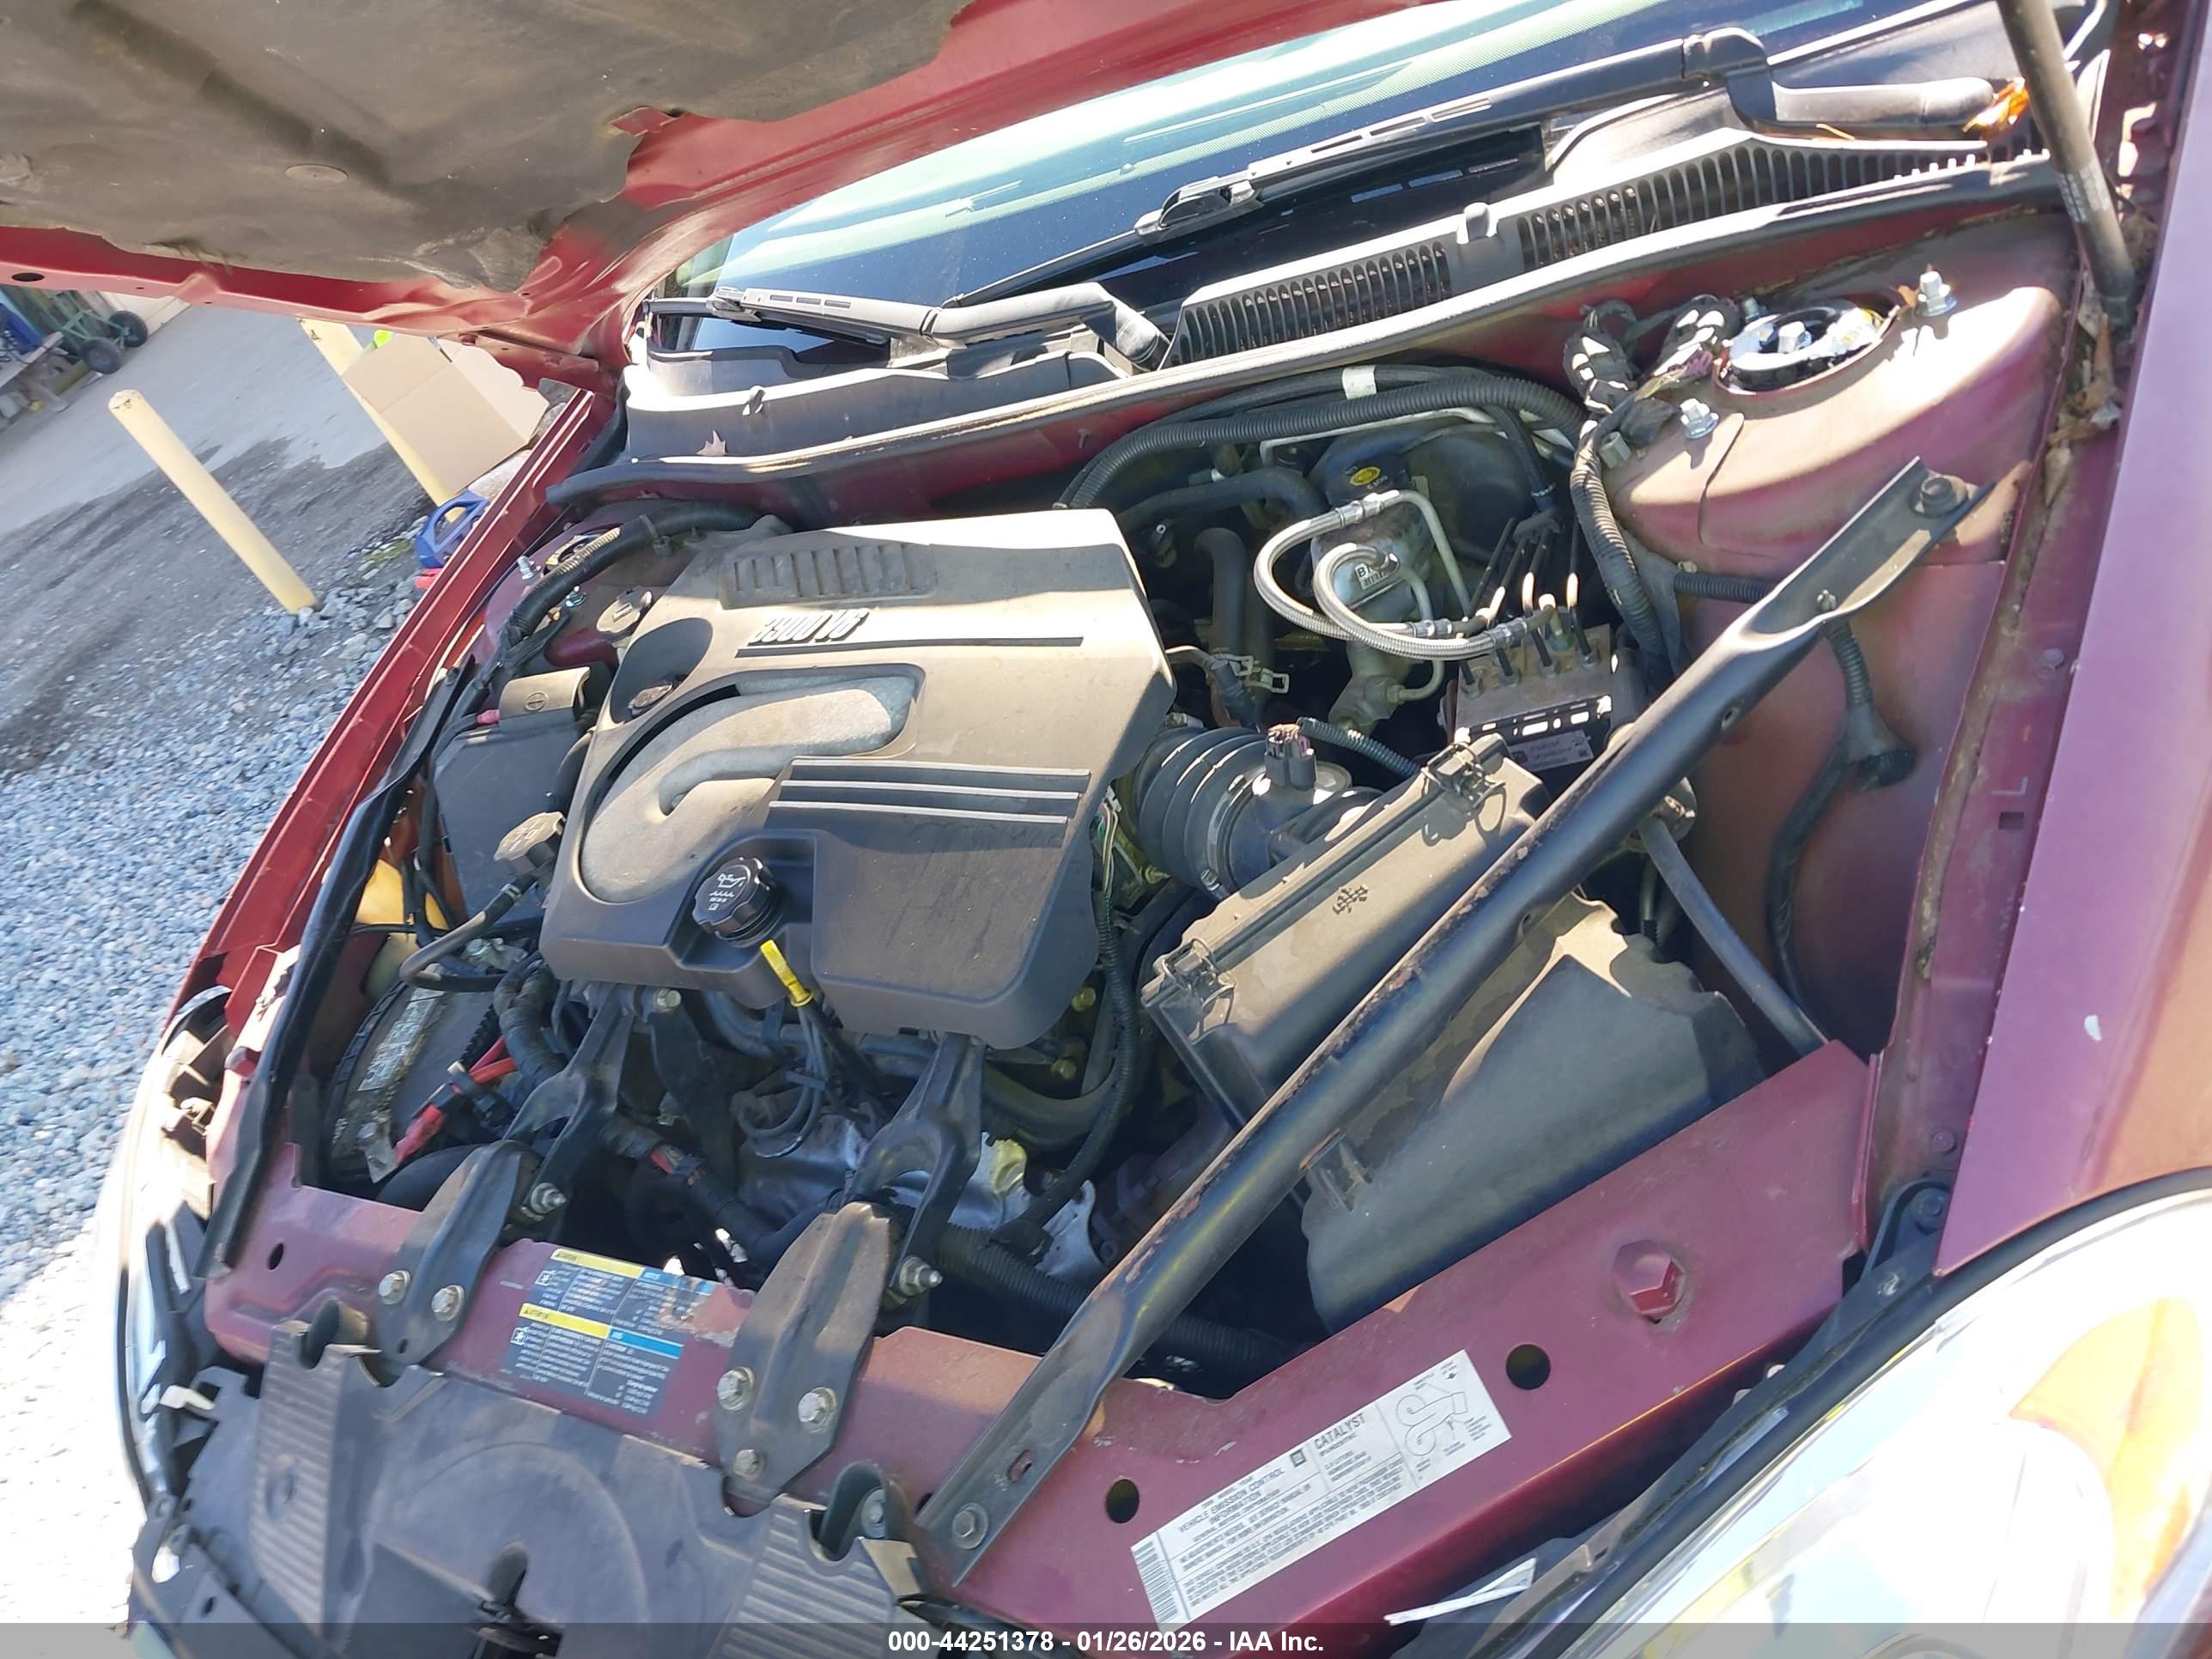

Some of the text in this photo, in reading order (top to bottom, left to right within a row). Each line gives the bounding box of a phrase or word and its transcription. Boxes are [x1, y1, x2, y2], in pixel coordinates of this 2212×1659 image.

[817, 607, 870, 642] V6
[1313, 1412, 1366, 1450] CATALYST
[1178, 1465, 1285, 1534] VEHICLE EMISSION CONTROL
[1208, 1489, 1261, 1525] INFORMATION
